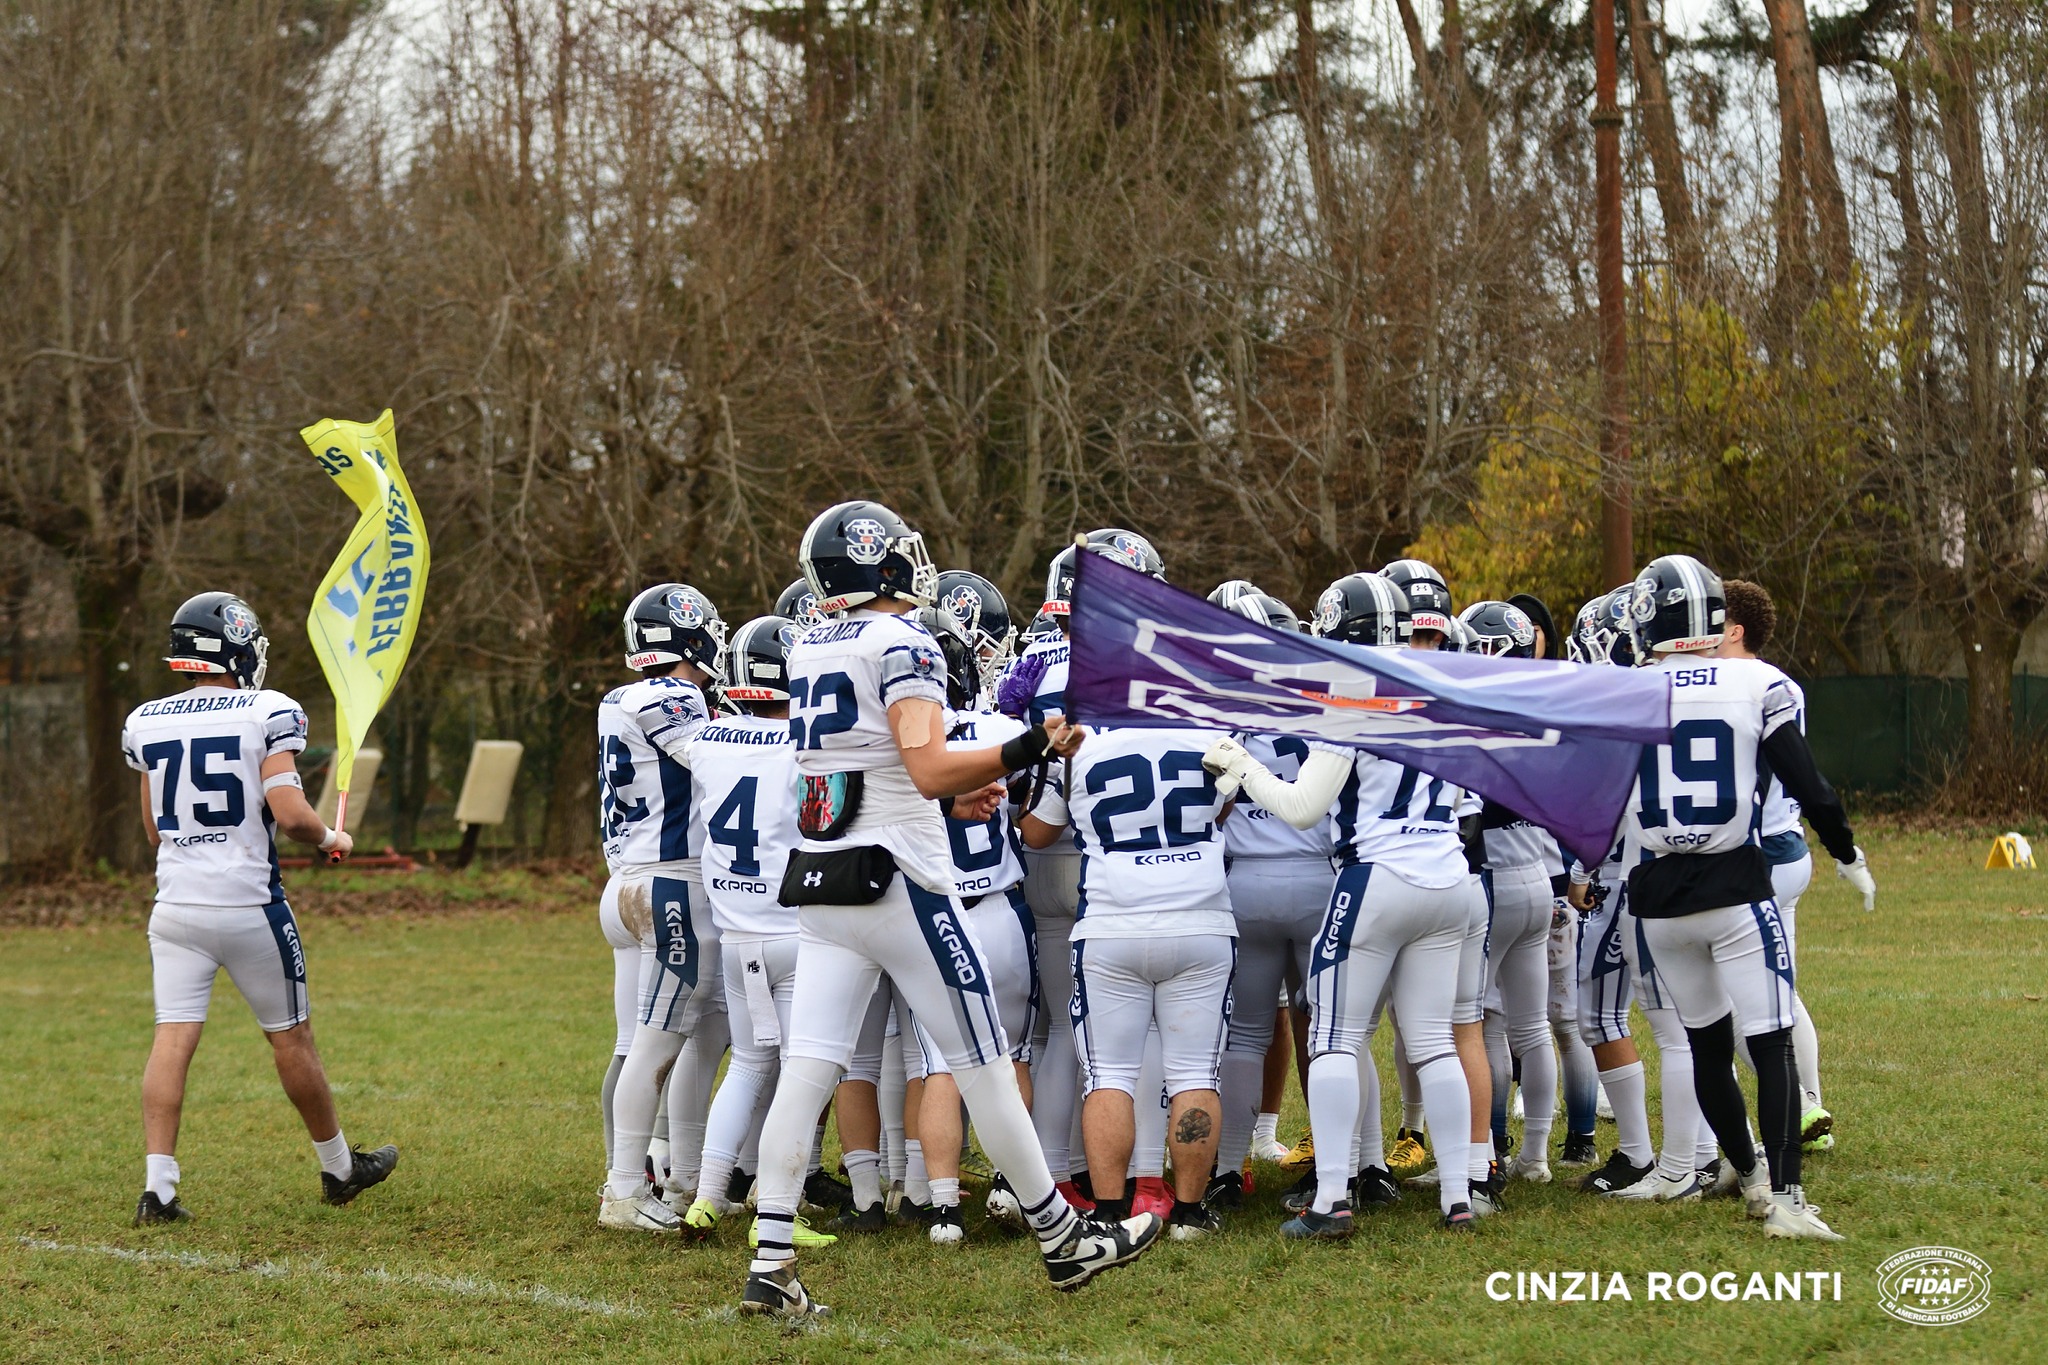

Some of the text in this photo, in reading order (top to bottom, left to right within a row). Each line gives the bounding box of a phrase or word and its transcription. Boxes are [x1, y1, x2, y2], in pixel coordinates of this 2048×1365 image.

[818, 597, 849, 612] ddell
[802, 620, 873, 645] SEAMEN
[631, 653, 658, 667] ddell
[1664, 667, 1718, 688] SSI
[140, 693, 258, 717] ELGHARABAWI
[693, 725, 792, 746] BOMMARI
[142, 735, 246, 831] 75
[1636, 718, 1737, 830] 19
[1085, 750, 1220, 855] 22
[708, 776, 761, 877] 4
[954, 876, 992, 892] PRO
